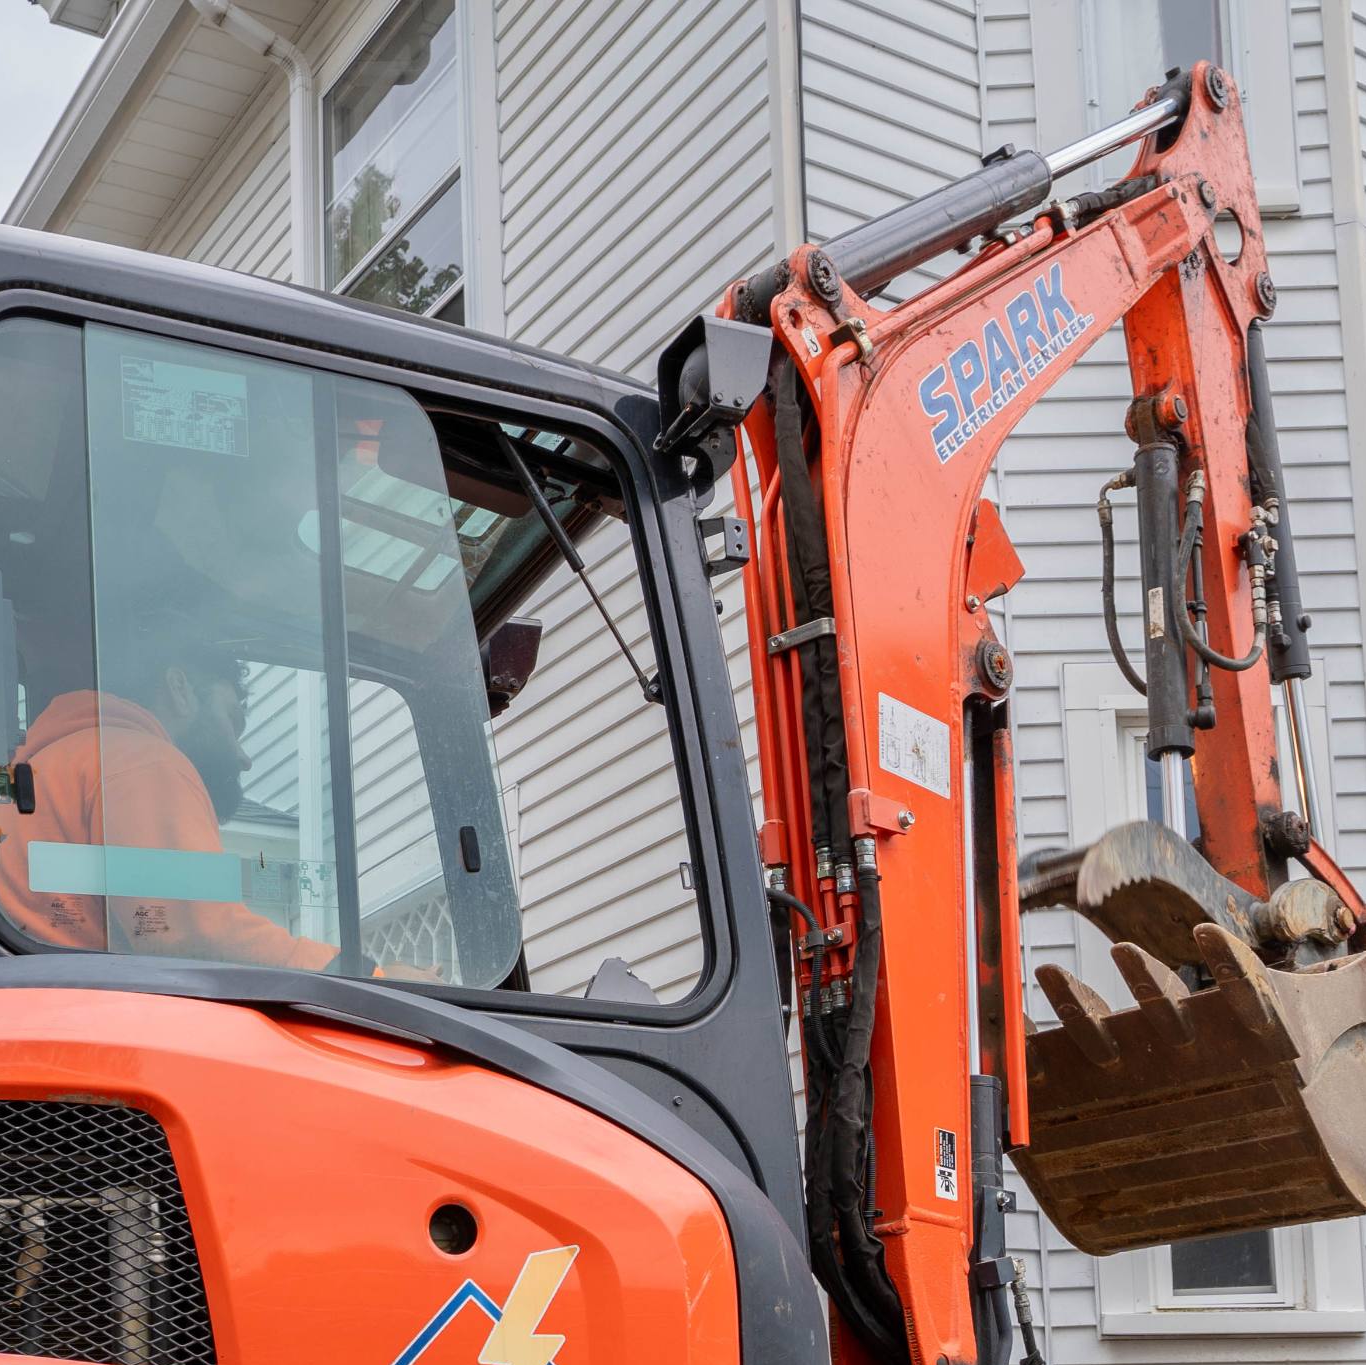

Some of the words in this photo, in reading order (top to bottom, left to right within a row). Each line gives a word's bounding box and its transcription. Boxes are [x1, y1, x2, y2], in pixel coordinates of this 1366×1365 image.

[919, 262, 1076, 446] SPARK
[936, 372, 1027, 463] ELECTRICIAN
[1026, 315, 1086, 379] SERVICES
